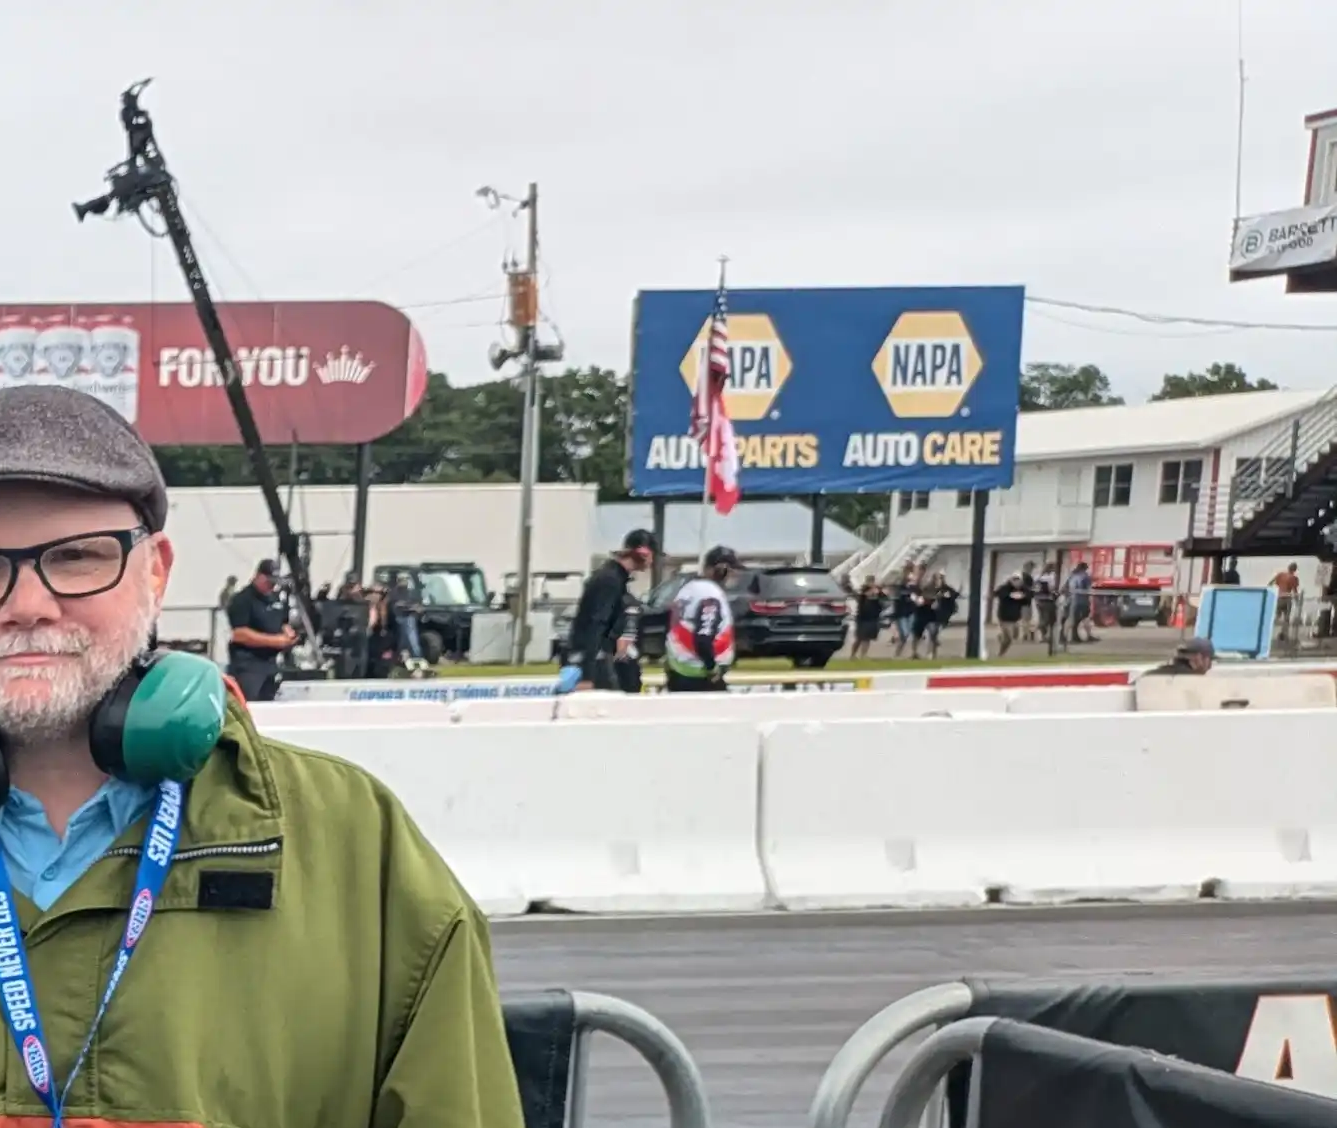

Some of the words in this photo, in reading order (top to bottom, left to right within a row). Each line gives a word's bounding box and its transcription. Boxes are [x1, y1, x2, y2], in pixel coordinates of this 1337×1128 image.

[159, 348, 220, 388] FOR
[238, 346, 309, 386] YOU
[700, 345, 772, 389] APA
[890, 343, 964, 387] NAPA
[646, 434, 712, 470] AUT
[843, 431, 919, 468] AUTO
[923, 430, 1002, 466] CARE
[147, 823, 177, 867] LIES
[2, 979, 37, 1032] SPEED
[26, 1044, 45, 1086] NHRA
